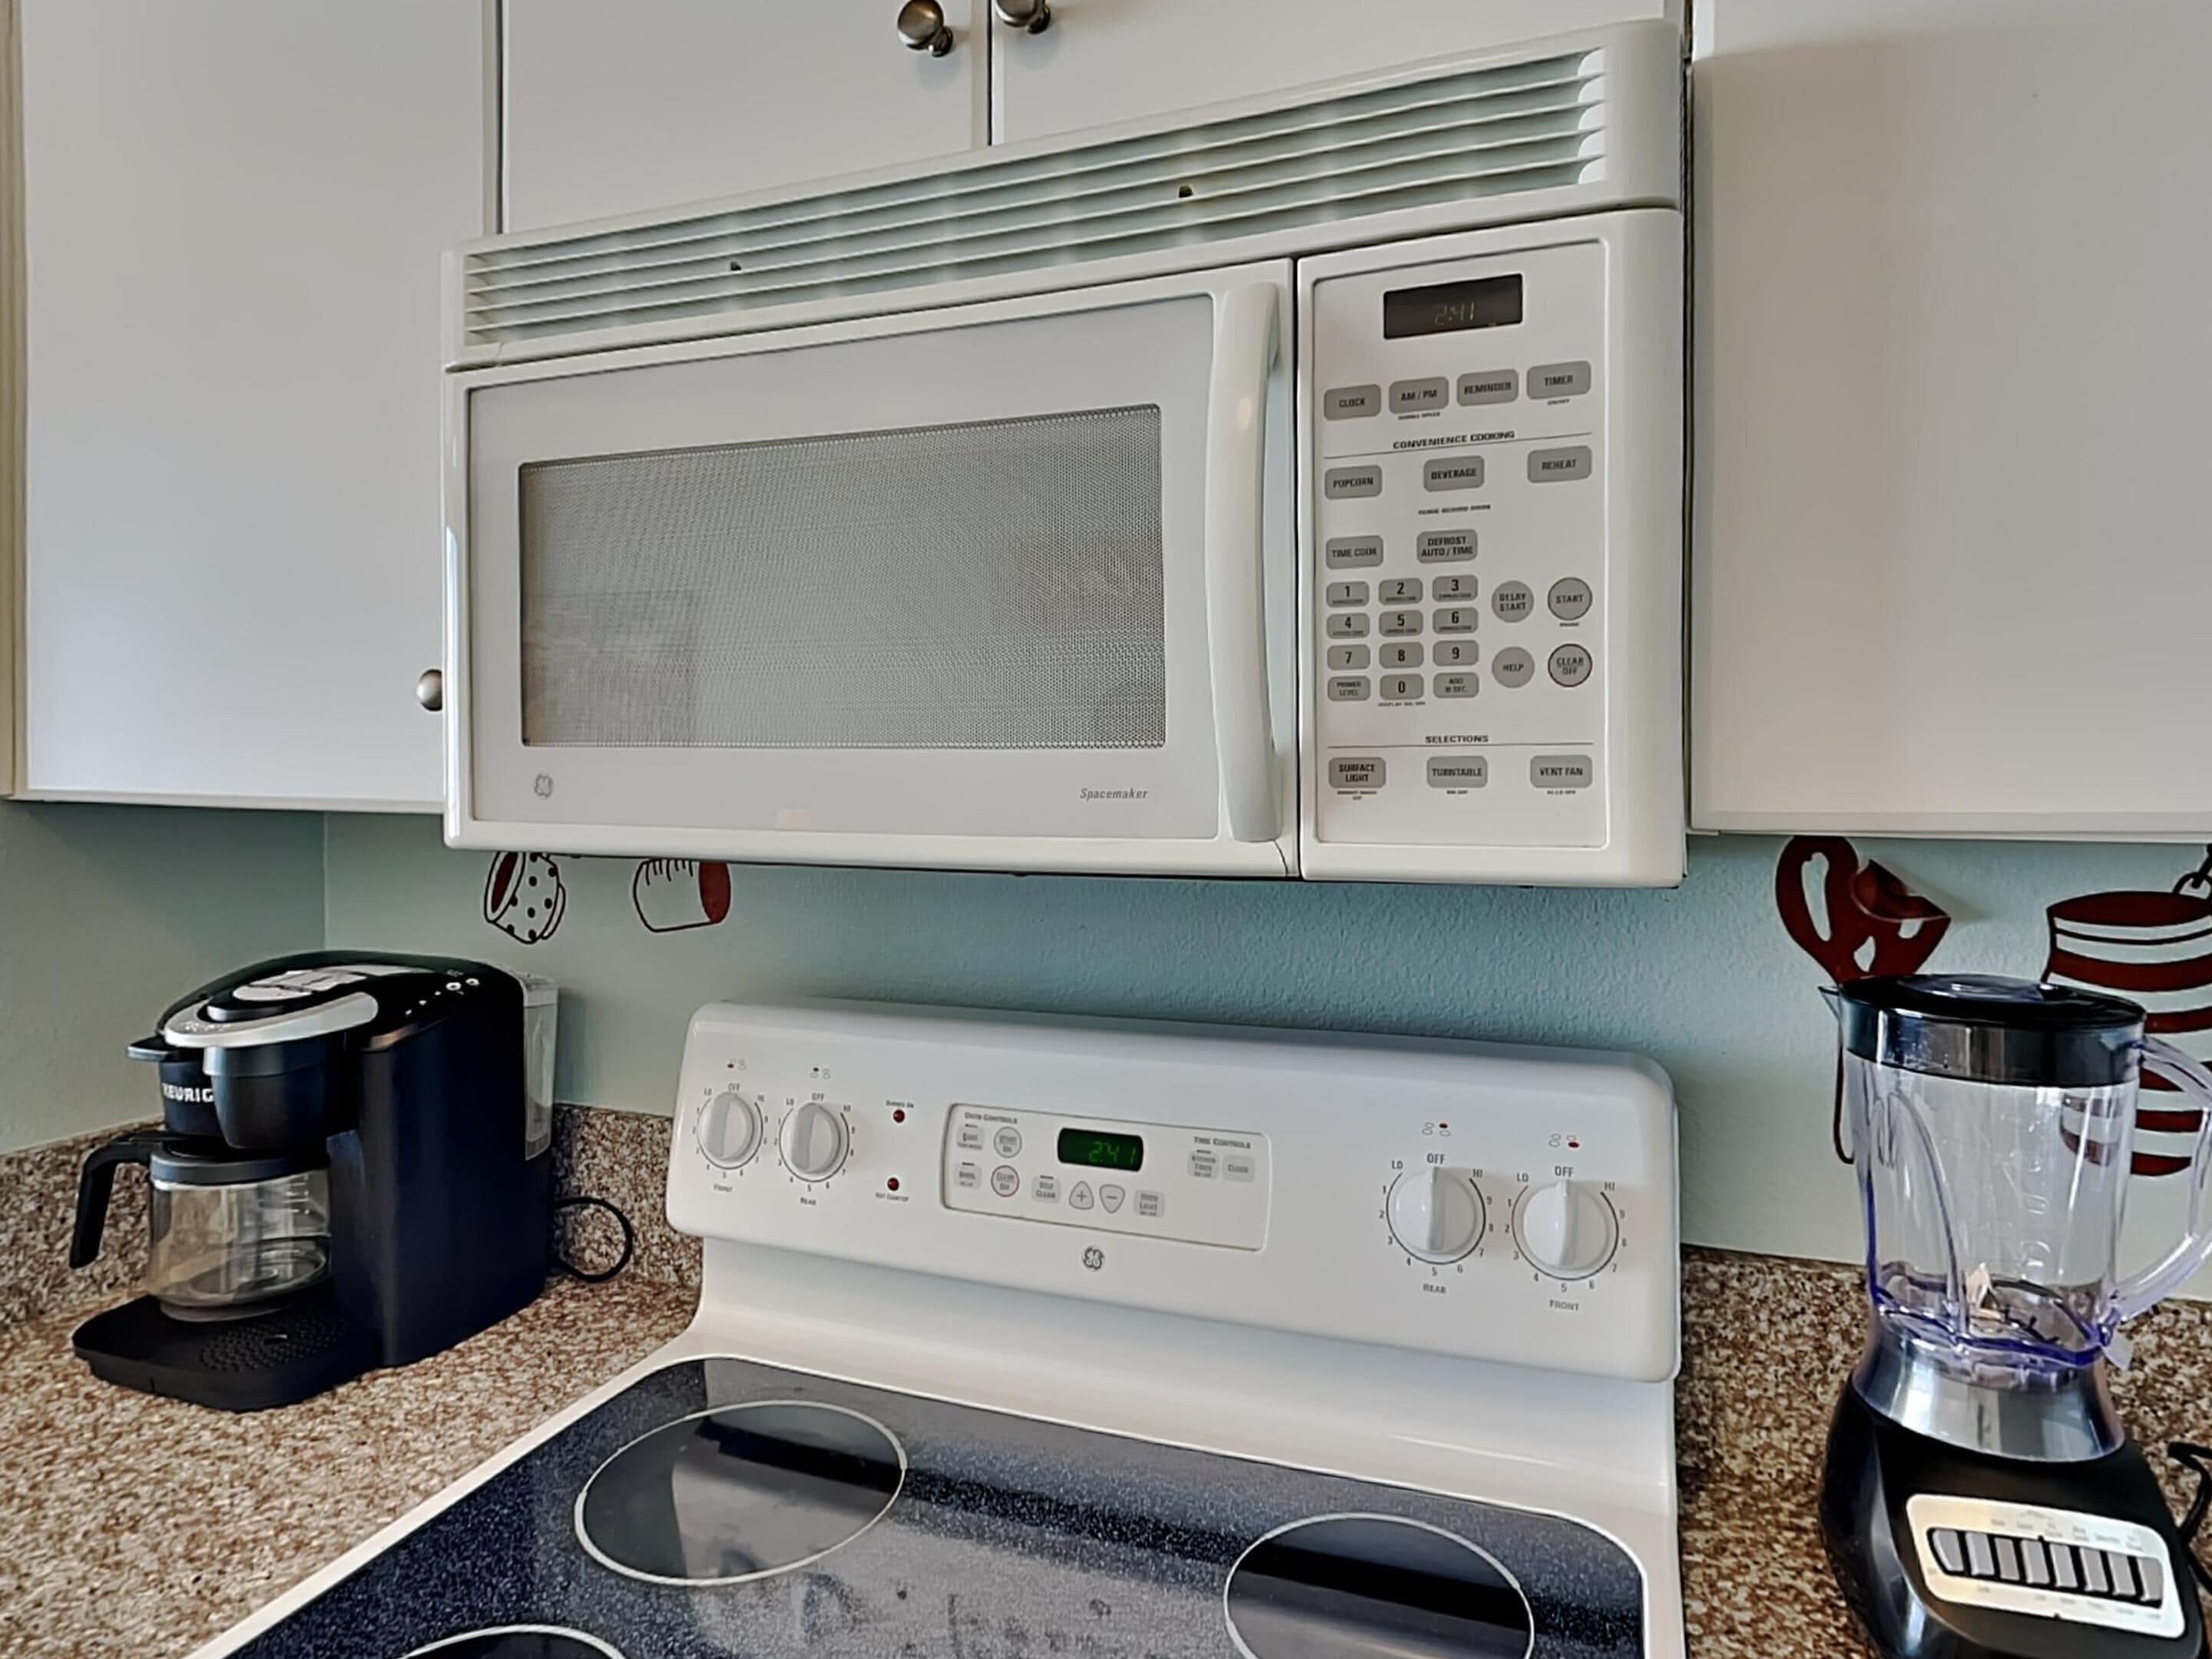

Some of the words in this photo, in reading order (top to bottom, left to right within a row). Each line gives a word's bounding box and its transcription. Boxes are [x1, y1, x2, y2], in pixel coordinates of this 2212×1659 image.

[1544, 375, 1574, 387] TIMER
[1464, 381, 1512, 395] REMINDER
[1400, 392, 1416, 402] AM
[1422, 389, 1438, 399] PM
[1339, 397, 1366, 408] CLOCK
[1392, 434, 1468, 449] CONVENIENCE
[1469, 430, 1515, 442] COOKING
[1541, 459, 1578, 470] REHEAT
[1430, 467, 1478, 480] BEVERAGE
[1333, 477, 1374, 489] POPCORN
[1427, 535, 1467, 547] DEFROST
[1331, 548, 1353, 559] TIME
[1354, 547, 1378, 558] COOK
[1421, 547, 1445, 558] AUTO
[1452, 545, 1474, 556] TIME
[1396, 581, 1406, 594] 2
[1450, 578, 1460, 592] 3
[1345, 585, 1351, 598] 1
[1498, 592, 1527, 602] DELAY
[1555, 594, 1584, 604] START
[1498, 602, 1527, 612] START
[1344, 617, 1352, 629] 4
[1396, 614, 1406, 627] 5
[1451, 611, 1460, 624] 6
[1345, 651, 1353, 664] 7
[1397, 649, 1406, 662] 8
[1451, 647, 1460, 660] 9
[1502, 664, 1525, 672] HELP
[1556, 657, 1584, 667] CLEAR
[1397, 680, 1406, 694] 0
[1425, 734, 1489, 744] SELECTIONS
[1339, 763, 1376, 773] SURFACE
[1431, 768, 1483, 777] TURNTABLE
[1539, 767, 1562, 777] VENT
[1565, 767, 1584, 777] FAN
[1345, 773, 1370, 783] LIGHT
[1079, 786, 1149, 803] Spacemaker
[1426, 1153, 1445, 1164] OFF
[1391, 1160, 1404, 1170] LO
[1554, 1165, 1574, 1177] OFF
[1472, 1168, 1483, 1178] HI
[1516, 1172, 1529, 1183] LO
[1604, 1181, 1615, 1191] HI
[1548, 1299, 1580, 1312] FRONT
